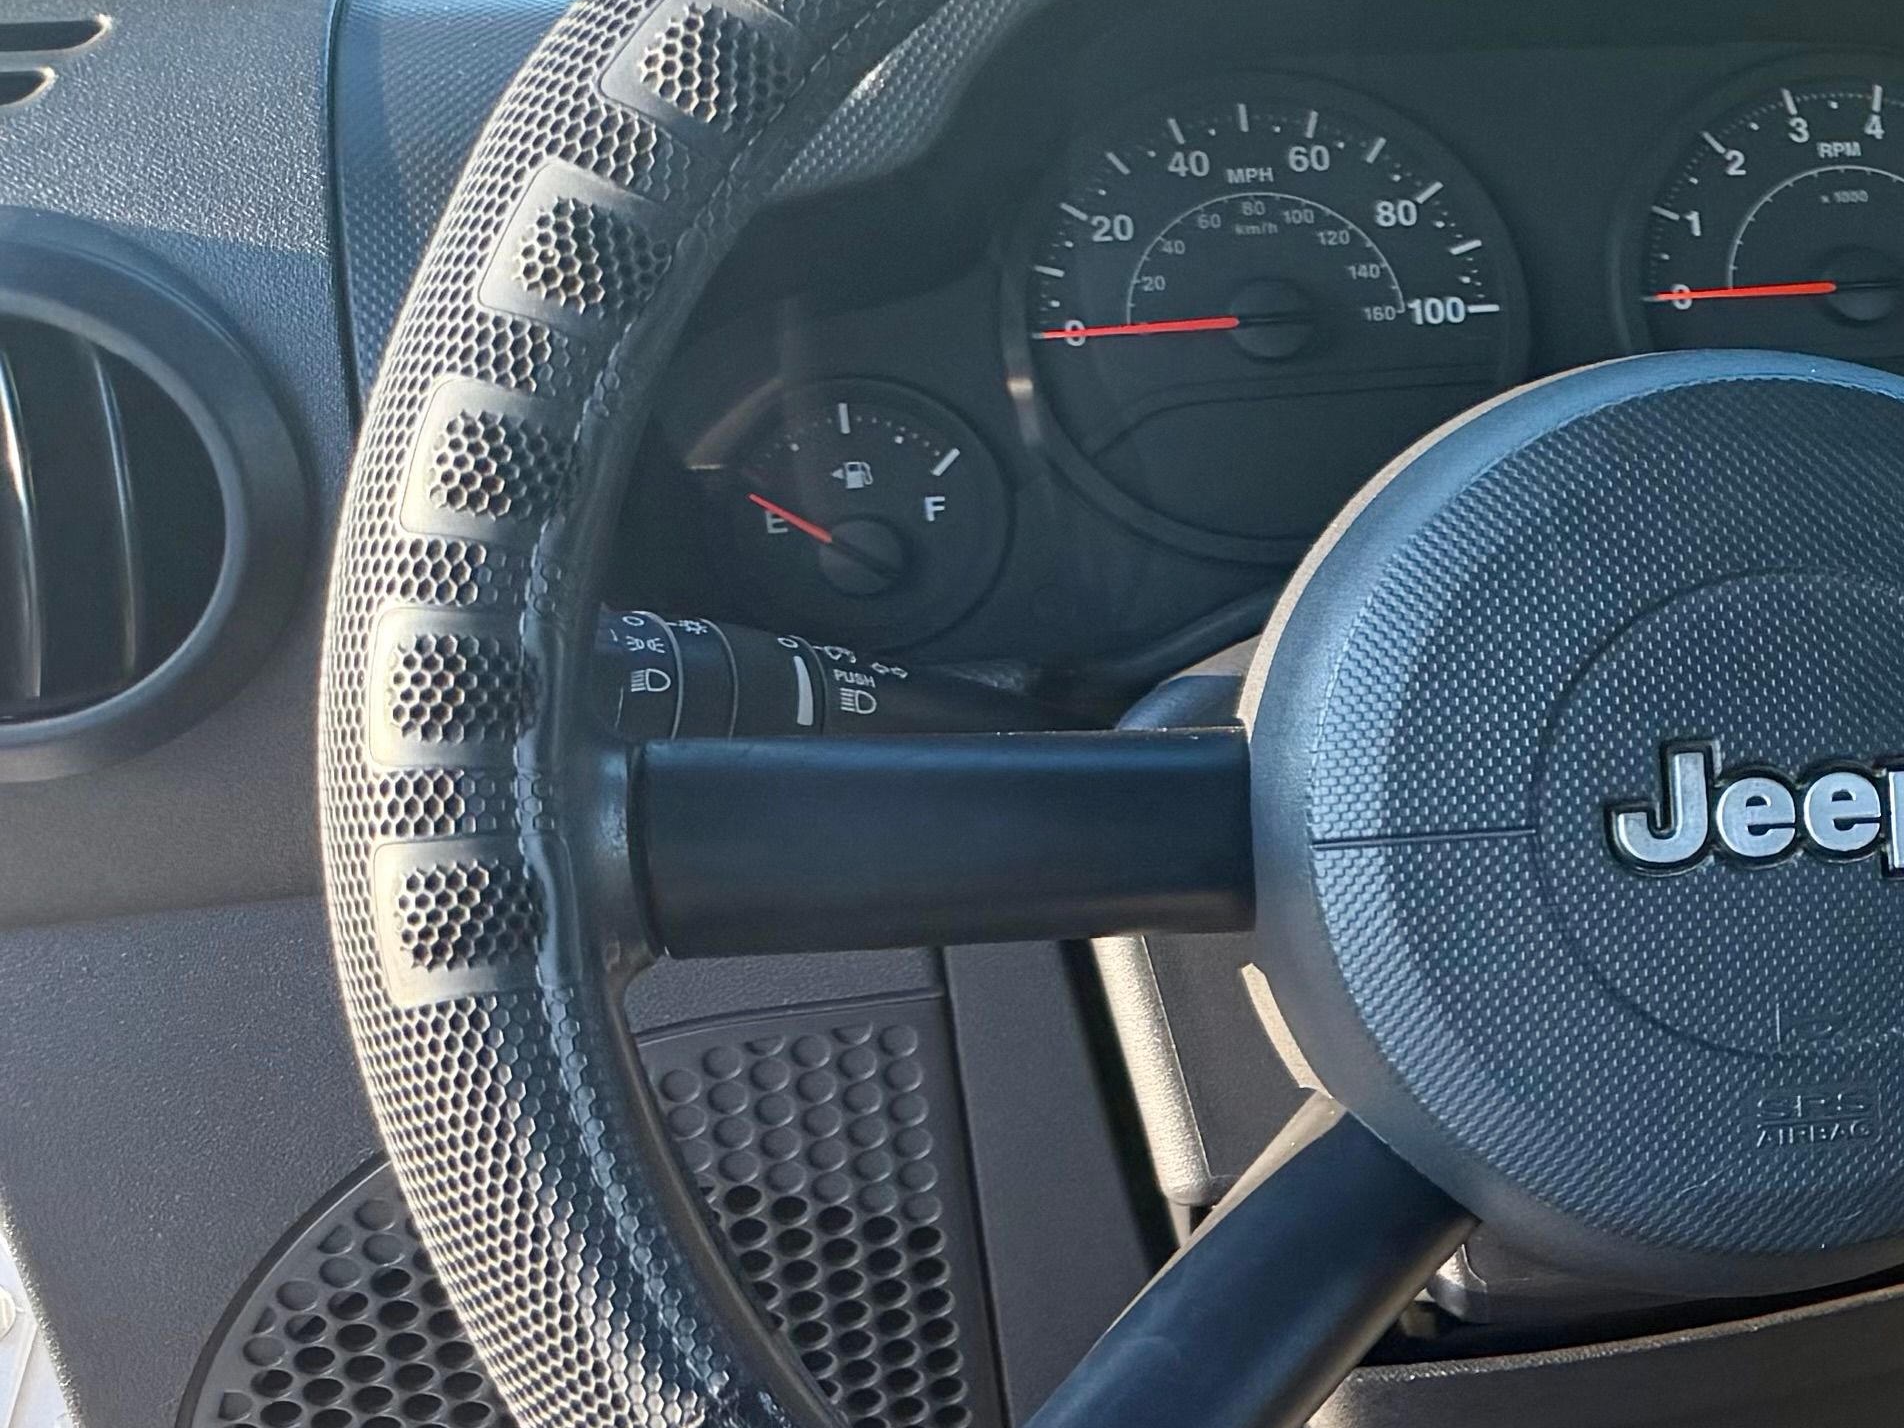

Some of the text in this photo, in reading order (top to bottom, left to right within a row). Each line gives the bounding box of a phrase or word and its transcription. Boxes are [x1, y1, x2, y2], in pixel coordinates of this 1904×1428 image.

[1787, 117, 1810, 143] 3
[1863, 114, 1885, 140] 4
[1287, 144, 1331, 173] 60
[1815, 141, 1863, 159] RPM
[1166, 150, 1211, 178] 40
[1724, 149, 1747, 176] 2
[1225, 167, 1275, 184] MPH
[1241, 200, 1266, 216] 80
[1282, 208, 1316, 224] 100
[1374, 199, 1418, 228] 80
[1091, 214, 1135, 243] 20
[1198, 213, 1222, 229] 60
[1234, 222, 1279, 236] km/h
[1683, 210, 1701, 237] 1
[1161, 239, 1186, 255] 40
[1316, 230, 1351, 246] 120
[1142, 275, 1166, 292] 20
[1347, 264, 1382, 280] 140
[1363, 305, 1397, 322] 160
[1406, 296, 1466, 325] 100
[924, 495, 946, 522] F
[764, 509, 789, 535] E
[833, 668, 877, 689] PUSH
[1755, 1121, 1873, 1149] AIRBAG
